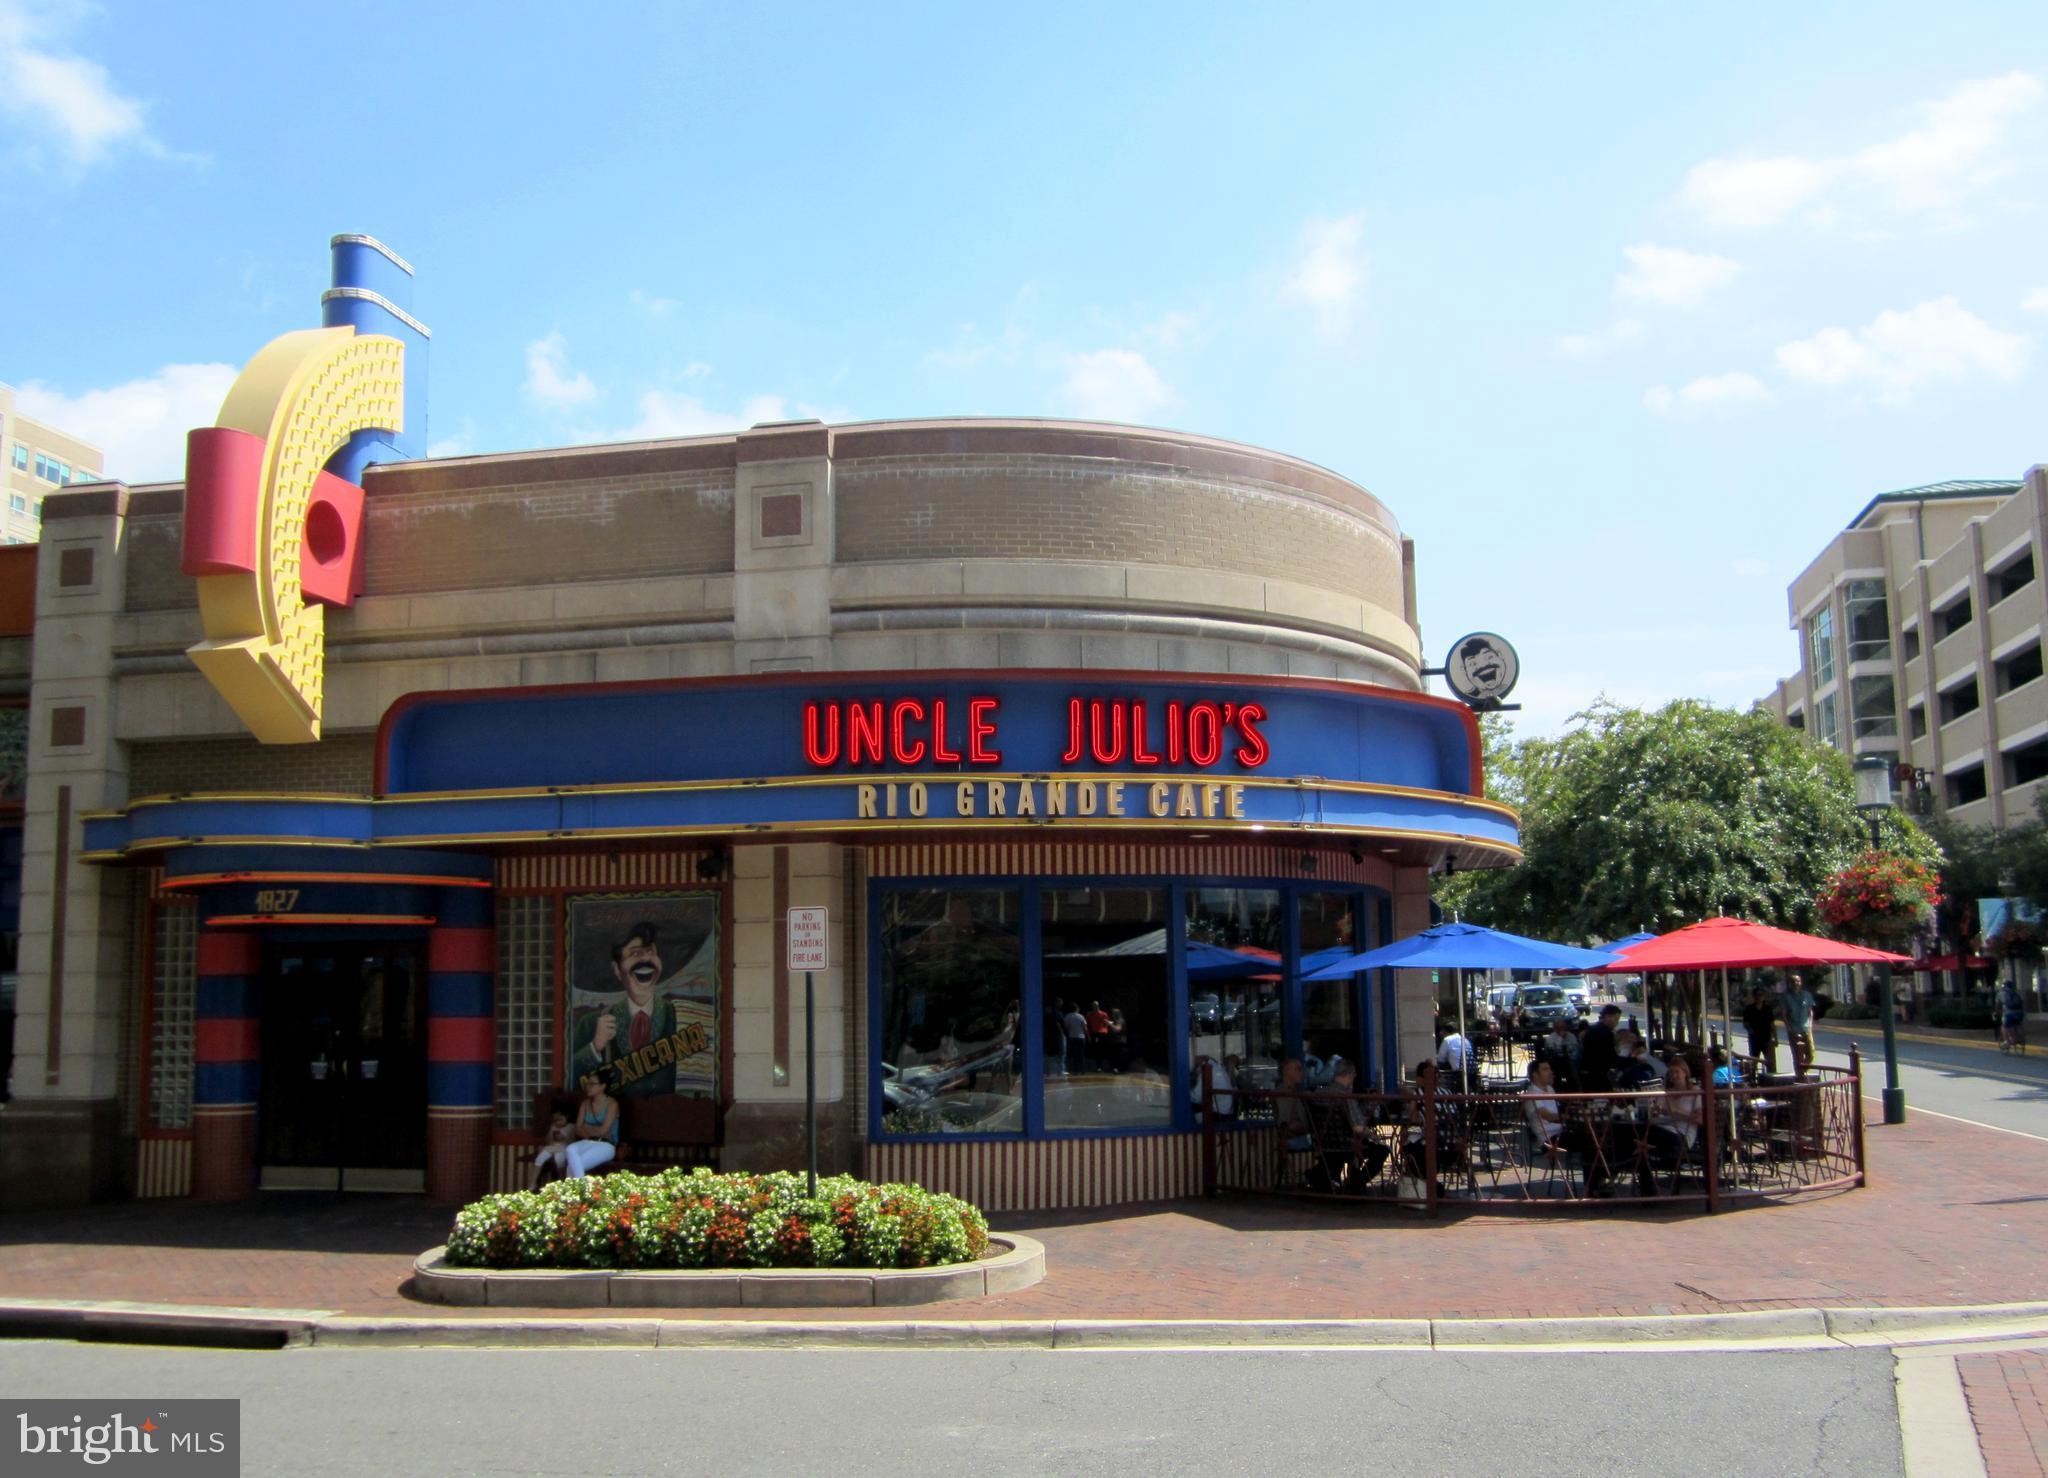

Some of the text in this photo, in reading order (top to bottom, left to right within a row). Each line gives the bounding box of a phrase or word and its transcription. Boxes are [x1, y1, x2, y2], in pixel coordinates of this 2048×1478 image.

[803, 695, 1269, 768] UNCLE JULIO'S
[858, 781, 1245, 818] RIO GRANDE CAFE
[255, 889, 300, 912] 1827
[802, 912, 814, 921] NO
[794, 922, 822, 931] PARKING
[792, 939, 824, 949] STANDING
[792, 952, 823, 963] FIRE LANE
[579, 1022, 709, 1091] XICANA
